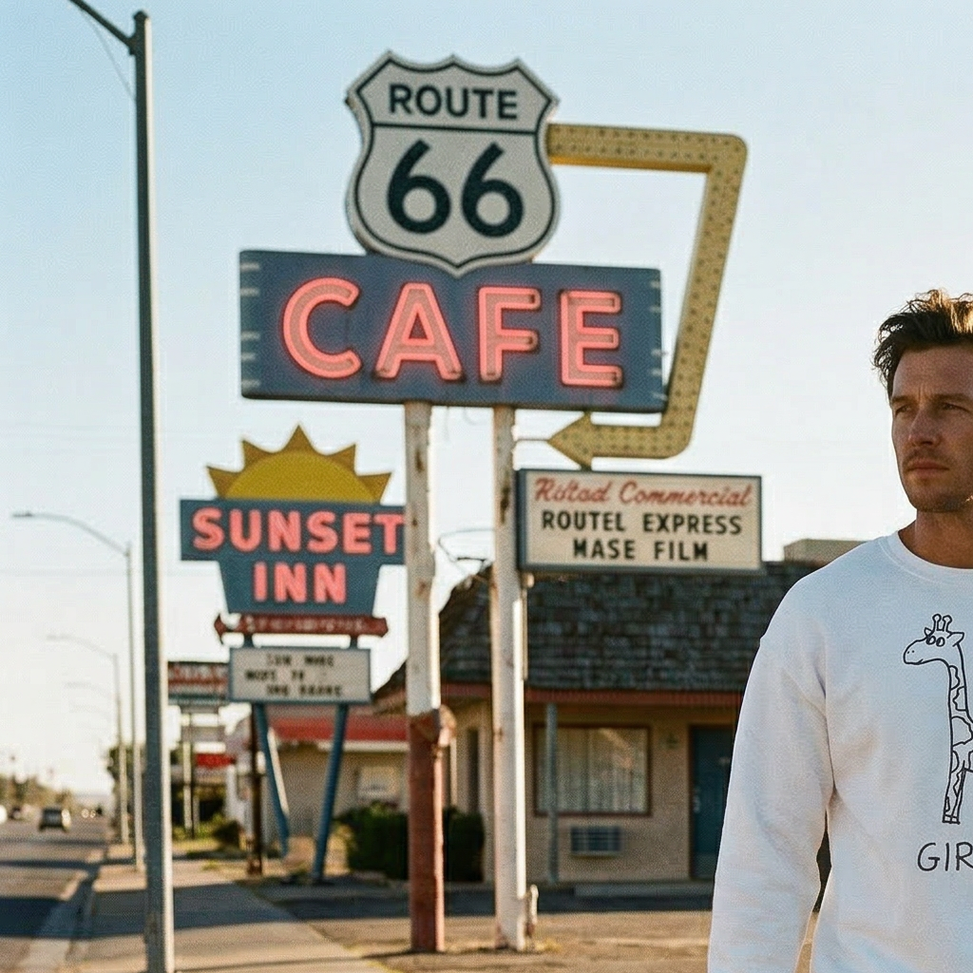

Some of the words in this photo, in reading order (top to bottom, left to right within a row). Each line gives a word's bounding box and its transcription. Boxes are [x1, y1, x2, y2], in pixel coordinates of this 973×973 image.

[389, 83, 518, 119] ROUTE
[387, 139, 524, 238] 66
[282, 277, 624, 389] CAFE
[618, 480, 753, 507] Commercial
[192, 506, 405, 554] SUNSET
[541, 510, 626, 532] ROUTEL
[642, 513, 743, 535] EXPRESS
[653, 540, 708, 561] FILM
[253, 561, 347, 604] INN
